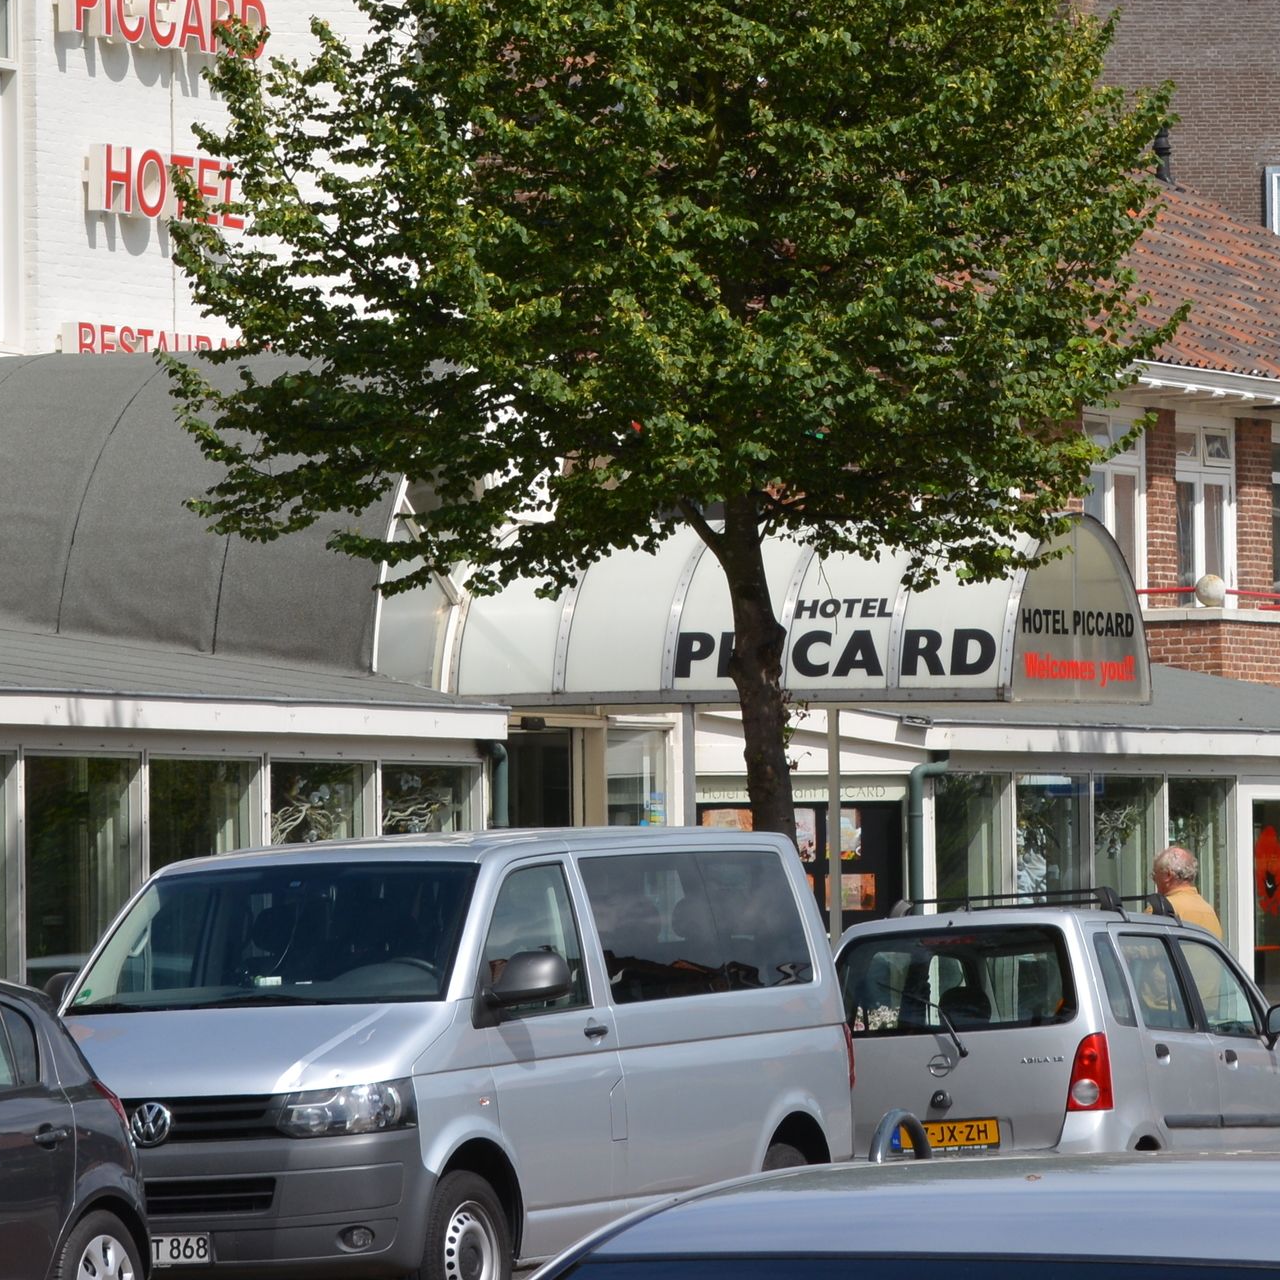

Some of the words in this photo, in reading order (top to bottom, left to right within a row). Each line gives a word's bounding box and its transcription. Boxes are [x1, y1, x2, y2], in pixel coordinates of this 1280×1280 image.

[104, 142, 245, 230] HOTEL
[794, 597, 894, 620] HOTEL
[1021, 608, 1069, 636] HOTEL
[1072, 610, 1135, 638] PICCARD
[674, 628, 997, 679] PICARD
[1023, 651, 1096, 681] Welcomes
[169, 1236, 208, 1261] 868
